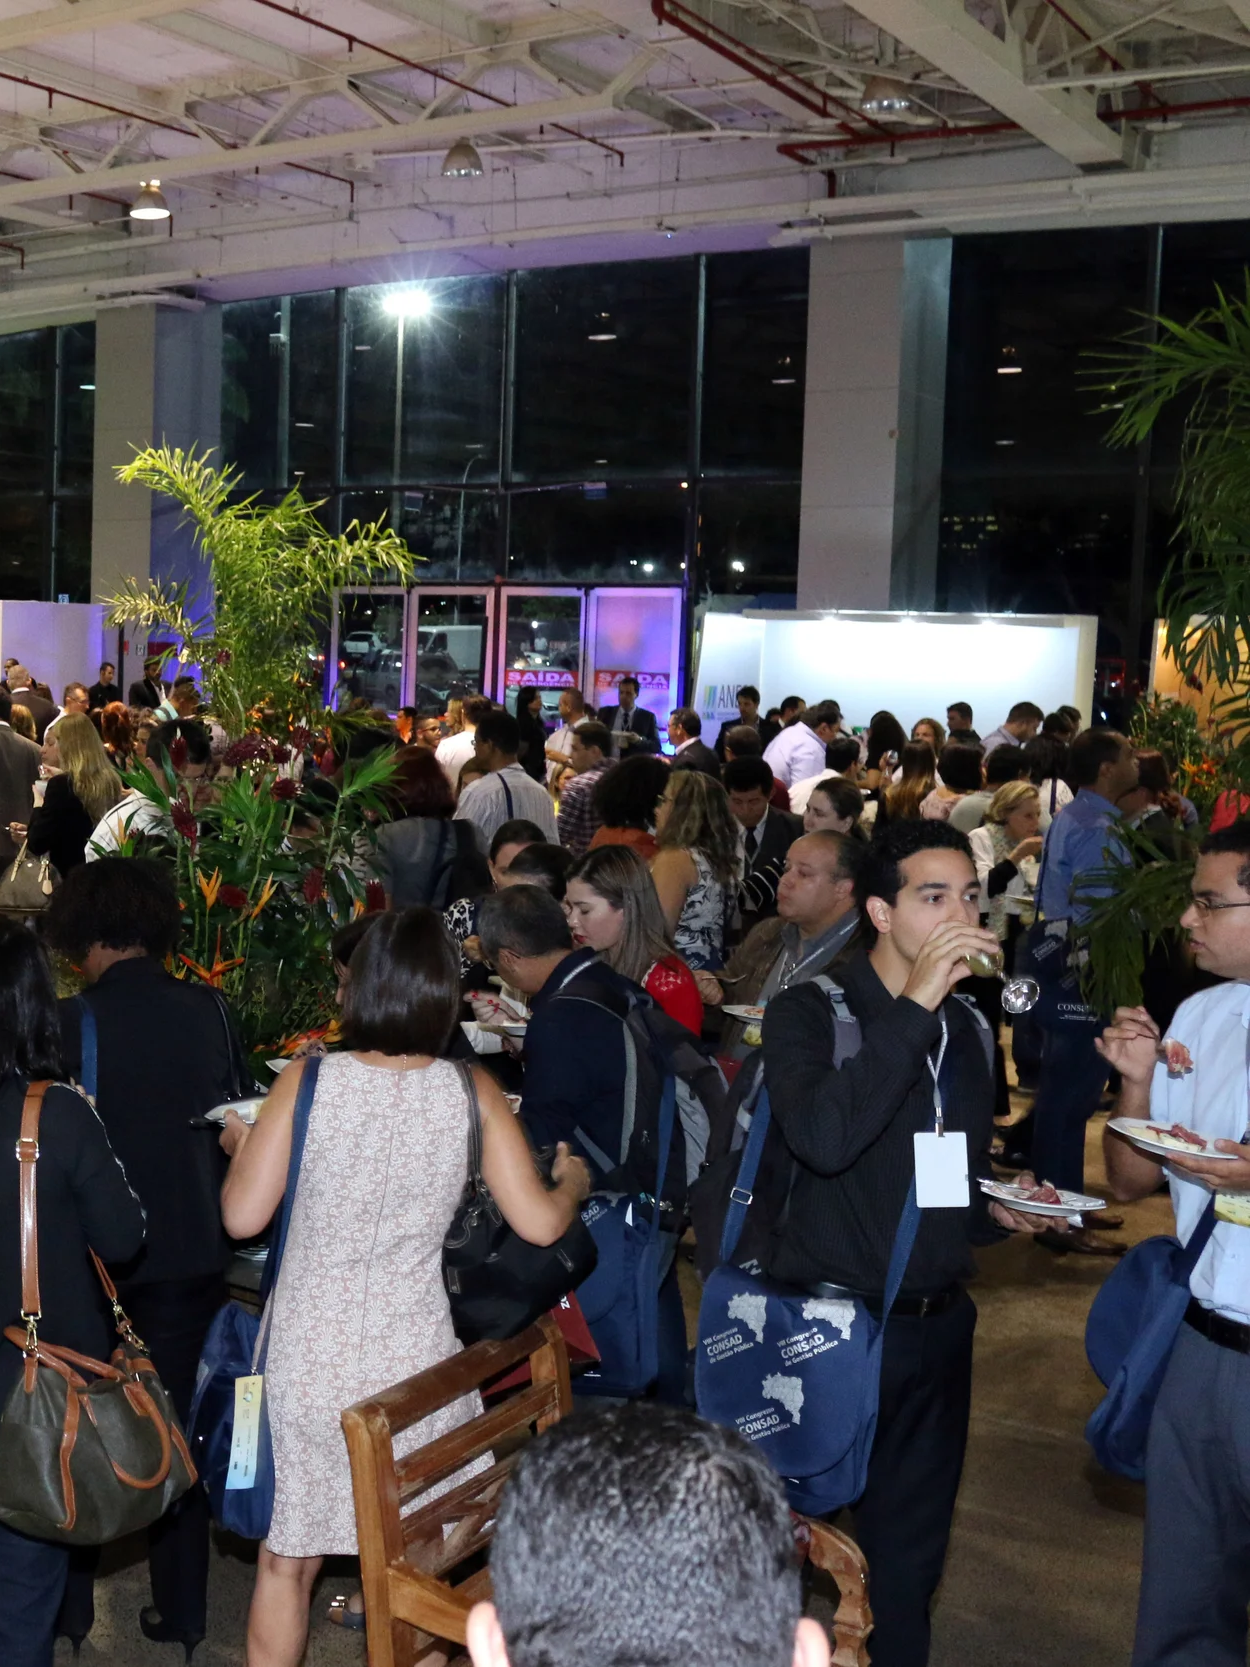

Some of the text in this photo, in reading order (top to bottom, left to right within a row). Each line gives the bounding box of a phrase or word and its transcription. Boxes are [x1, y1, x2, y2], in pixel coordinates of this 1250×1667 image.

[508, 671, 575, 682] SAÍDA
[707, 1334, 742, 1356] CONSAD
[781, 1334, 824, 1358] CONSAD
[792, 1352, 813, 1363] Gestão
[813, 1341, 838, 1355] Pública
[746, 1407, 775, 1421] Congresso
[739, 1415, 779, 1434] CONSAD
[751, 1430, 771, 1440] Gestão
